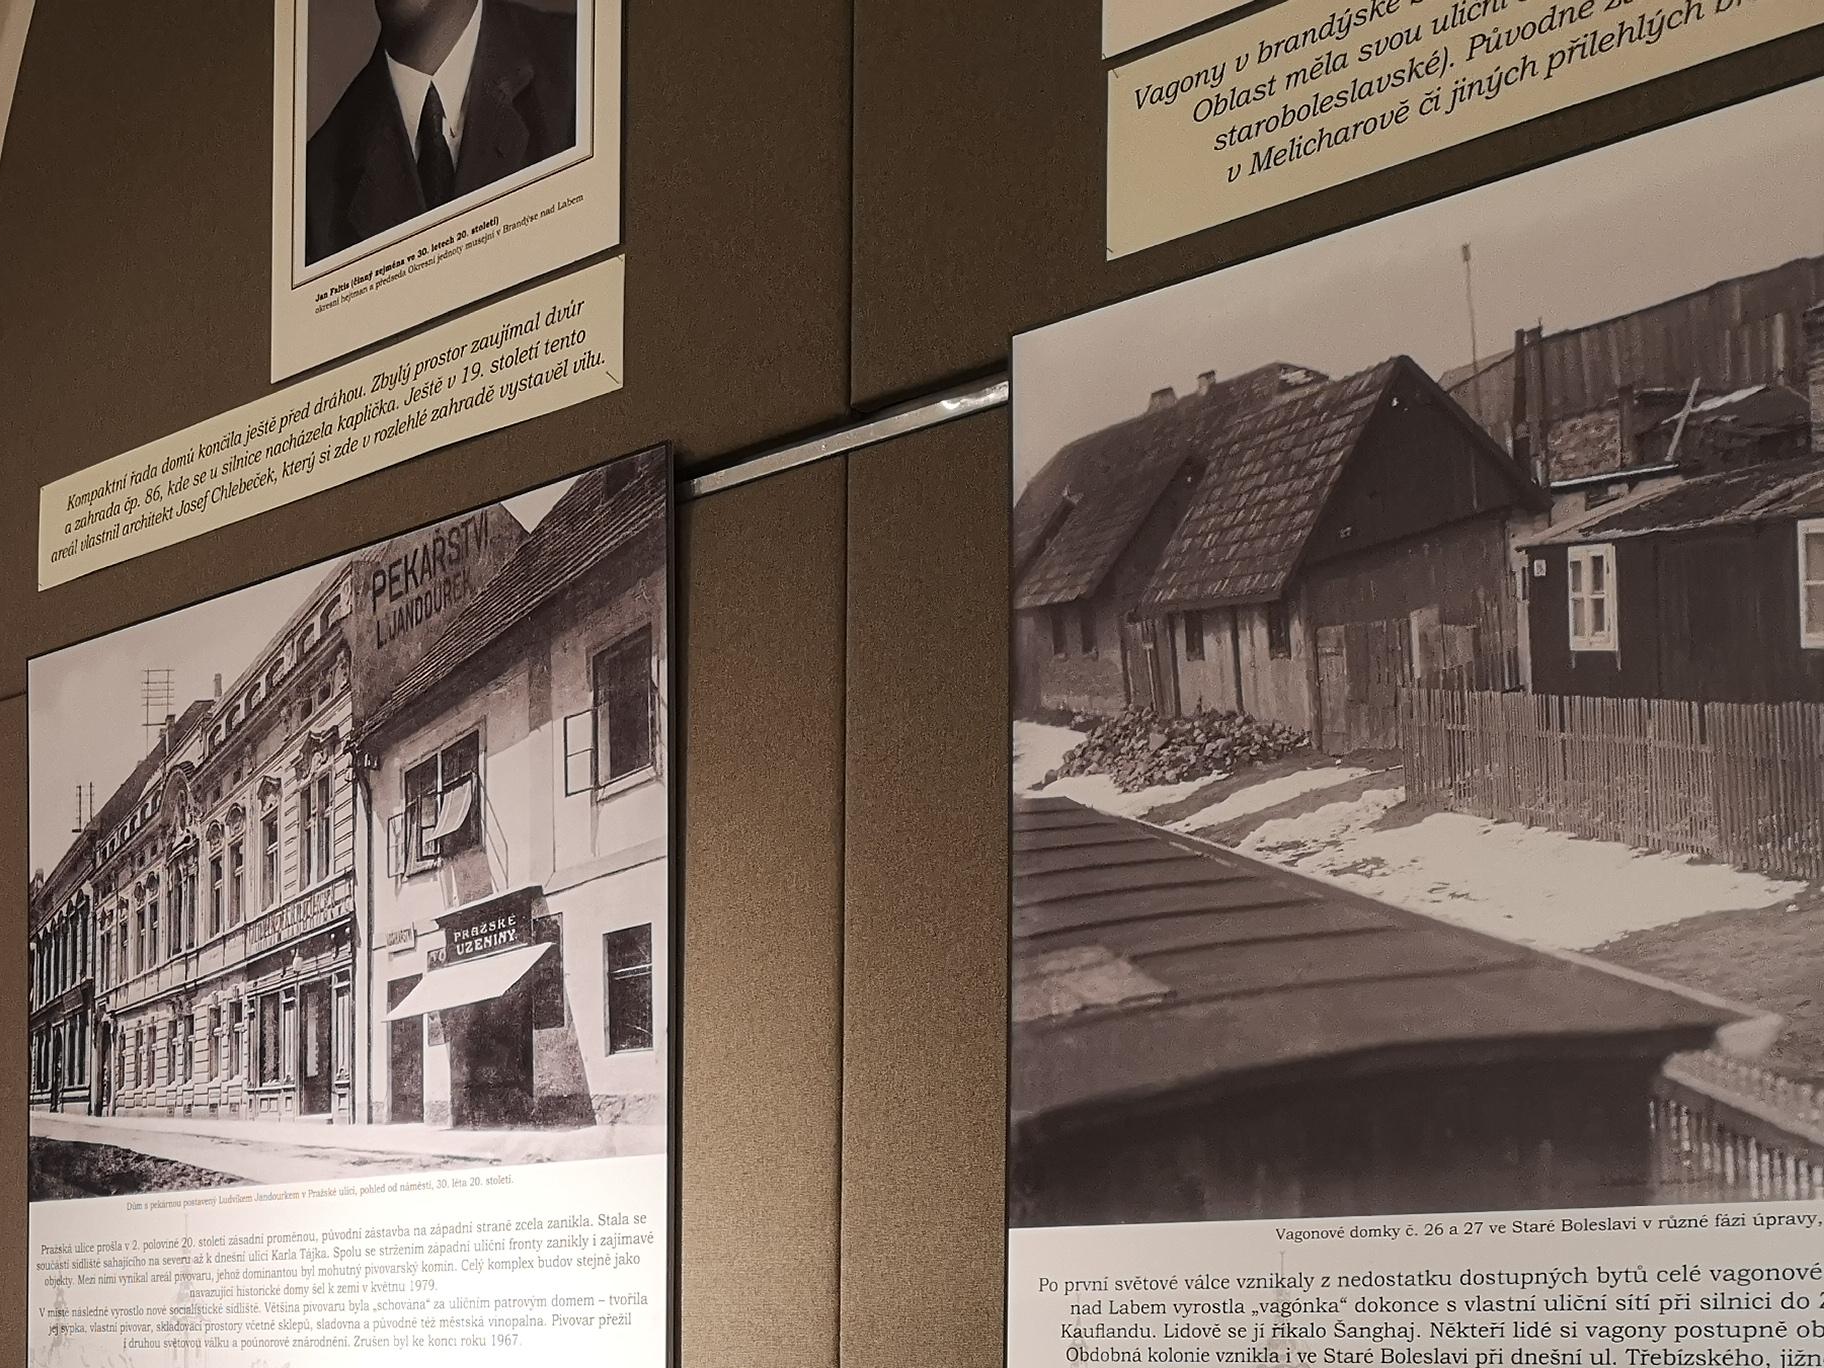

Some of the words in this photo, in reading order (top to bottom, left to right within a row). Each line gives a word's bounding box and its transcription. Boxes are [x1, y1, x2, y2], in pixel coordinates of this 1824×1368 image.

[1134, 62, 1226, 110] Vagony
[1235, 53, 1249, 73] v
[1193, 74, 1277, 123] Oblast
[1285, 50, 1349, 91] měla
[1357, 24, 1423, 62] svou
[1213, 48, 1454, 151] staroboleslavské).
[1227, 163, 1242, 183] v
[1248, 102, 1410, 176] Melicharově
[1418, 86, 1442, 116] či
[1444, 54, 1539, 115] jiných
[51, 538, 78, 563] areál
[80, 522, 120, 552] vlastnil
[122, 506, 174, 536] architekt
[175, 489, 211, 517] Josef
[211, 467, 278, 504] Chlebeček,
[282, 455, 316, 478] který
[318, 449, 331, 464] si
[333, 436, 359, 459] zde
[362, 434, 371, 448] v
[373, 410, 428, 444] rozlehlé
[430, 386, 495, 422] zahradě
[499, 358, 569, 401] vystavěl
[573, 351, 605, 374] vilu.
[64, 523, 72, 535] a
[74, 501, 121, 531] zahrada
[123, 497, 141, 515] čp.
[144, 484, 163, 505] 86,
[167, 475, 190, 496] kde
[192, 471, 207, 487] se
[210, 467, 218, 480] u
[221, 450, 263, 475] silnice
[265, 421, 333, 459] nacházela
[337, 398, 399, 432] kaplička.
[403, 380, 443, 406] Ještě
[447, 375, 457, 389] v
[461, 361, 484, 384] 19.
[489, 344, 539, 374] století
[544, 329, 586, 356] tento
[67, 473, 128, 511] Kompaktní
[130, 464, 158, 486] řada
[198, 431, 242, 459] končila
[242, 419, 277, 447] ještě
[277, 401, 311, 434] před
[313, 385, 366, 415] dráhou.
[370, 364, 411, 394] Zbylý
[412, 344, 468, 382] prostor
[470, 312, 541, 354] zaujímal
[1039, 1277, 1058, 1292] Po
[1064, 1276, 1108, 1296] první
[1114, 1275, 1178, 1291] světové
[1184, 1273, 1230, 1290] válce
[1236, 1272, 1315, 1293] vznikaly
[1320, 1276, 1331, 1288] z
[1337, 1269, 1452, 1288] nedostatku
[1459, 1266, 1588, 1290] dostupných
[1596, 1265, 1648, 1289] bytů
[1656, 1264, 1701, 1283] celé
[1709, 1262, 1823, 1287] vagonové
[1070, 1299, 1102, 1315] nad
[1109, 1299, 1167, 1315] Labem
[1173, 1298, 1246, 1319] vyrostla
[1251, 1297, 1347, 1319] „vagónka“
[1354, 1296, 1439, 1313] dokonce
[1446, 1300, 1457, 1313] s
[1464, 1294, 1536, 1312] vlastní
[1543, 1293, 1607, 1312] uliční
[1615, 1293, 1650, 1311] sítí
[1658, 1292, 1691, 1315] při
[1700, 1291, 1772, 1310] silnici
[1780, 1291, 1810, 1310] do
[1061, 1323, 1156, 1339] Kauflandu.
[1164, 1322, 1222, 1339] Lidově
[1227, 1326, 1247, 1339] se
[1251, 1322, 1265, 1343] jí
[1271, 1322, 1327, 1339] říkalo
[1333, 1321, 1421, 1343] Šanghaj.
[1430, 1321, 1505, 1339] Někteří
[1512, 1321, 1552, 1339] lidé
[1560, 1321, 1578, 1339] si
[1585, 1325, 1667, 1344] vagony
[1674, 1322, 1788, 1343] postupně
